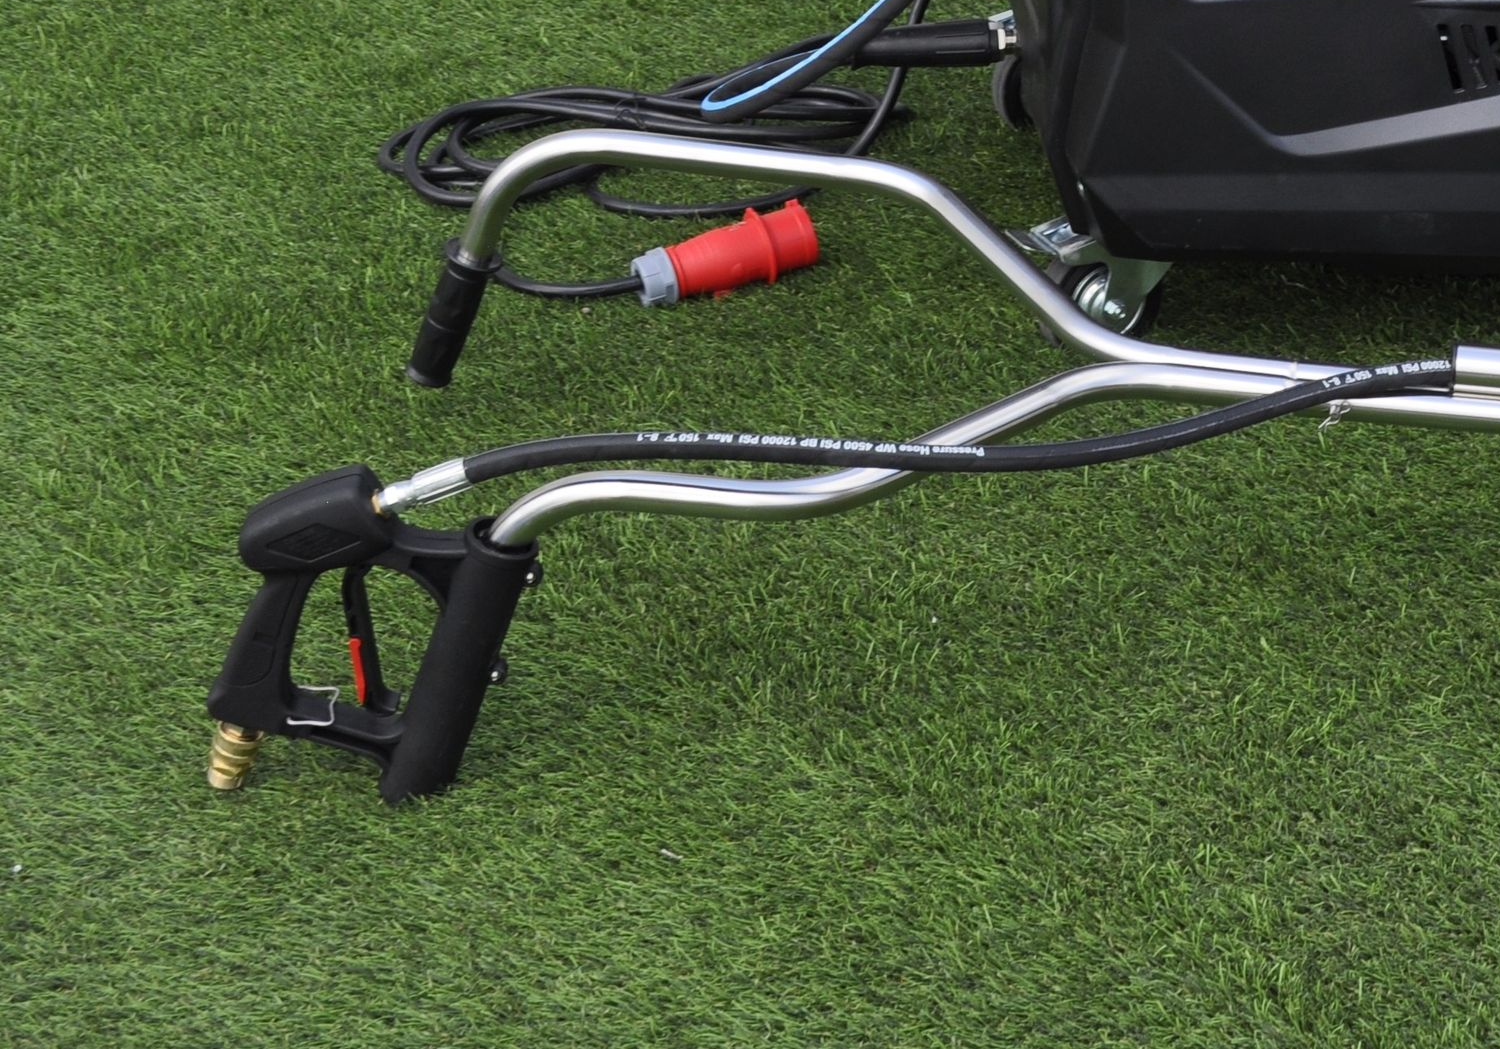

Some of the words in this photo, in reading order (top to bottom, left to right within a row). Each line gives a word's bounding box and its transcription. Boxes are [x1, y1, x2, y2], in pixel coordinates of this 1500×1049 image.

[1375, 365, 1399, 375] Max
[1401, 362, 1420, 373] PSI
[706, 432, 734, 443] Max
[738, 433, 759, 445] PSI
[761, 435, 797, 446] 12000
[800, 437, 818, 447] BP
[820, 438, 840, 450] PSI
[843, 440, 873, 451] 4500
[875, 442, 896, 453] WP
[899, 443, 930, 455] Hose
[932, 445, 985, 456] Pressure
